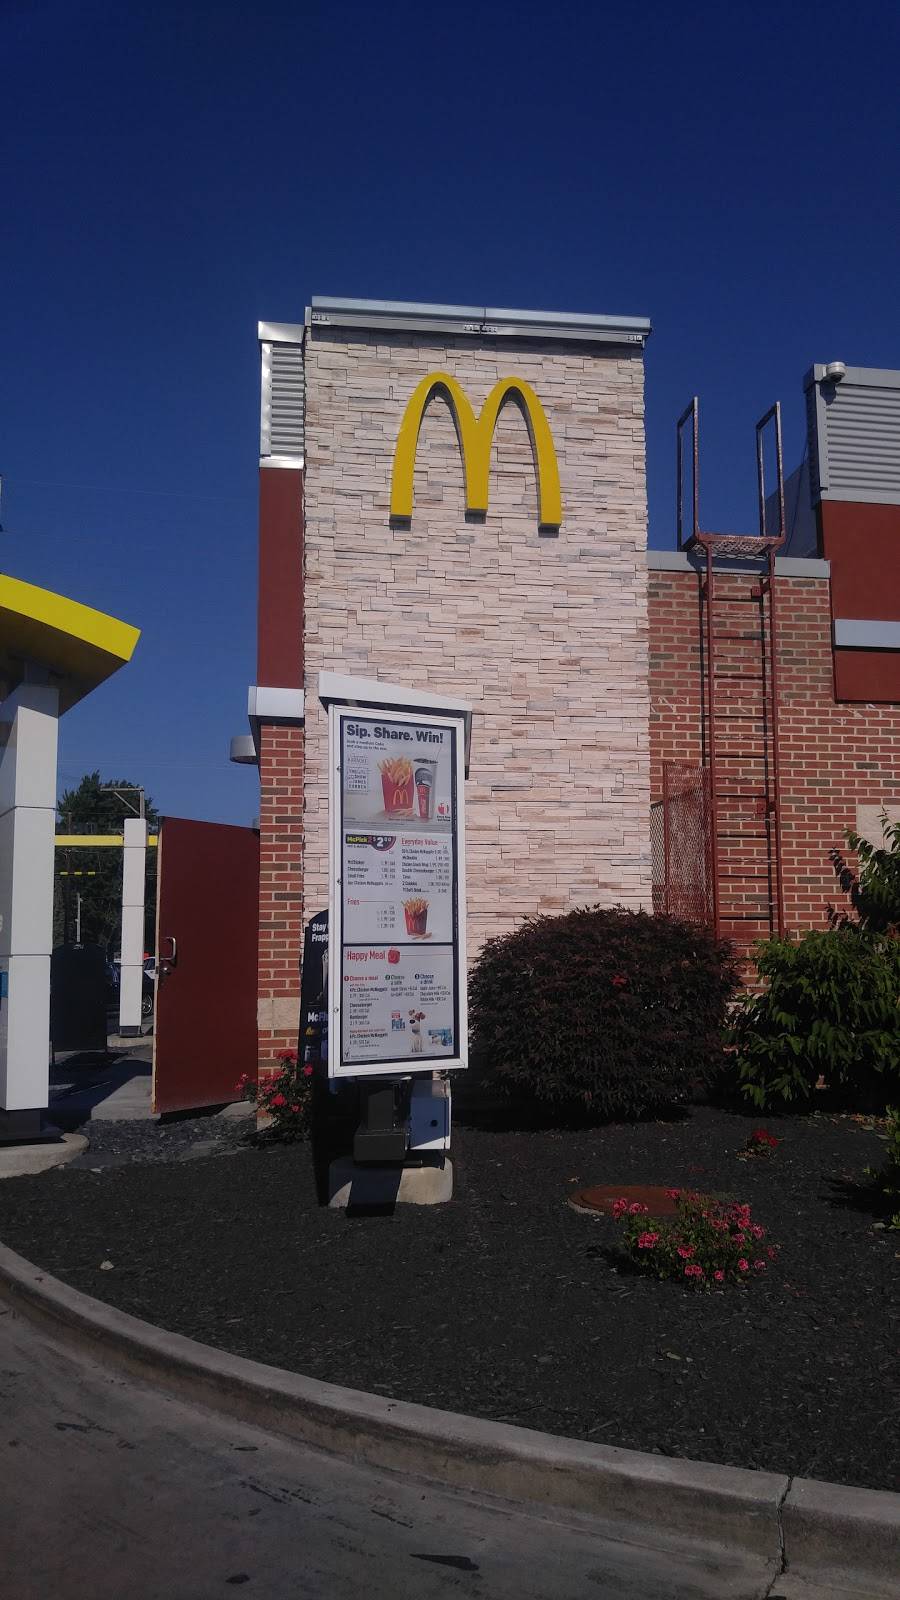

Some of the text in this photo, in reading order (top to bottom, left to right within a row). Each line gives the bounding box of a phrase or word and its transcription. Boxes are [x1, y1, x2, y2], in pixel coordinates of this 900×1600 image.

[347, 725, 444, 744] Sip. Share. Win!
[312, 923, 327, 933] Stay
[347, 950, 386, 962] Happy Meal
